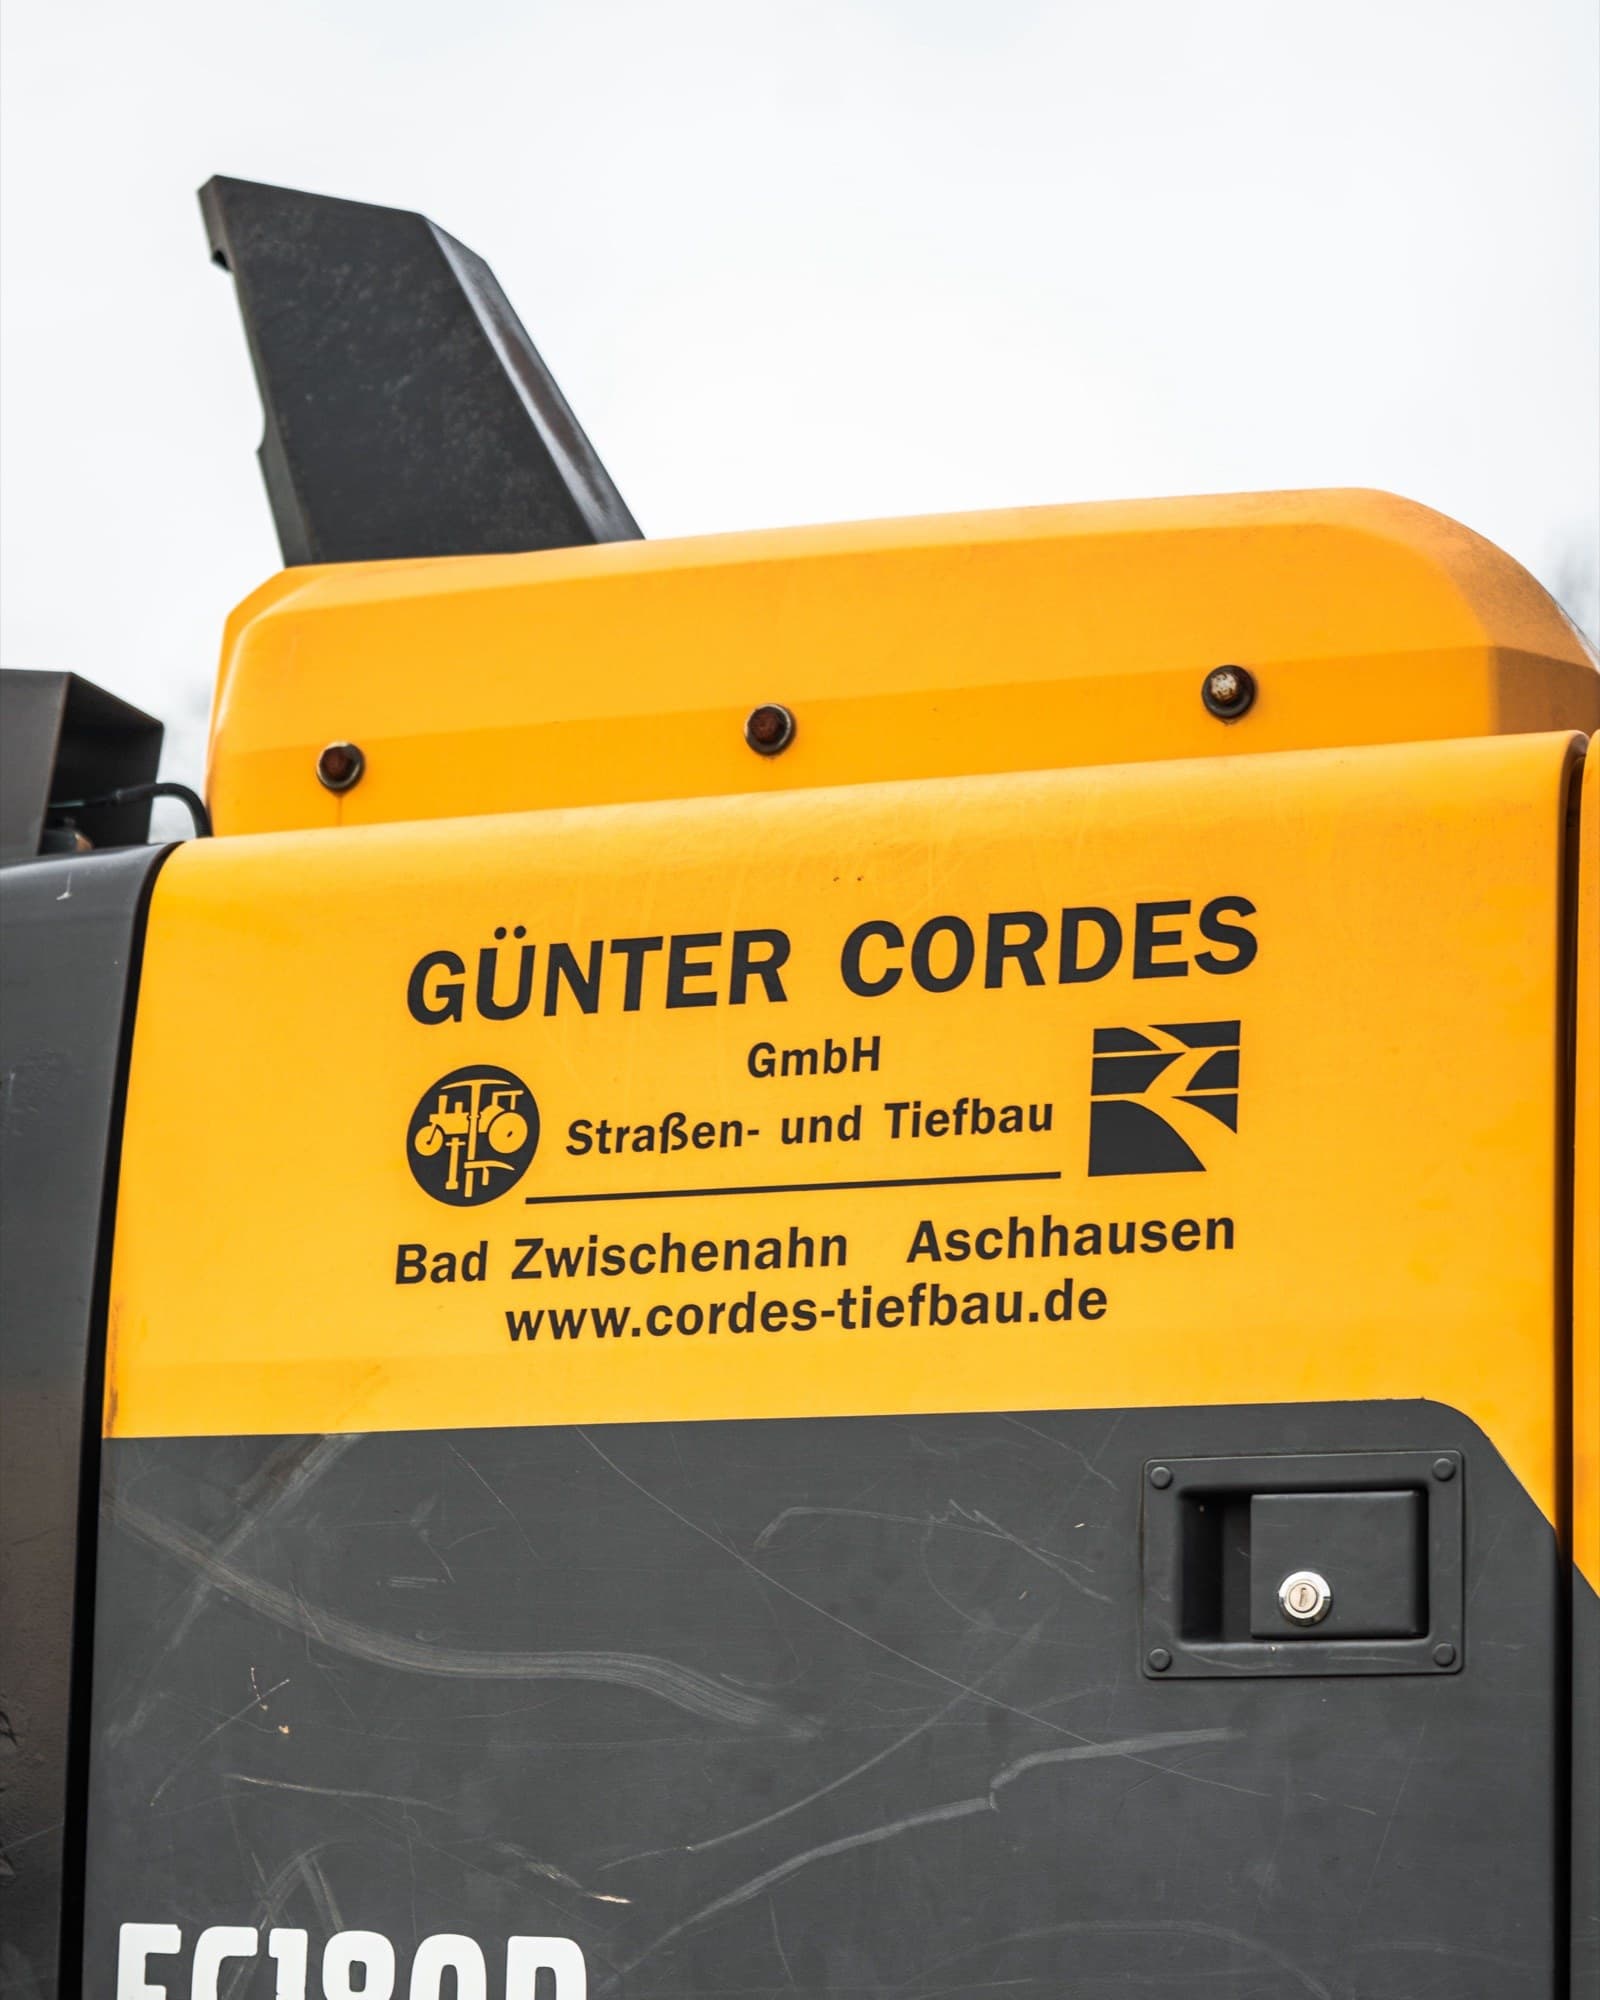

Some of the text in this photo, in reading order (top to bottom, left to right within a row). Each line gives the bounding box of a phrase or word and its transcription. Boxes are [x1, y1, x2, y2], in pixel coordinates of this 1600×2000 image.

[408, 896, 1257, 1025] GÜNTER CORDES
[748, 1036, 880, 1078] GmbH
[567, 1098, 1052, 1155] Straßen- und Tiefbau
[396, 1215, 1234, 1284] Bad Zwischenahn Aschhausen
[506, 1278, 1107, 1341] www.cordes-tiefbau.de
